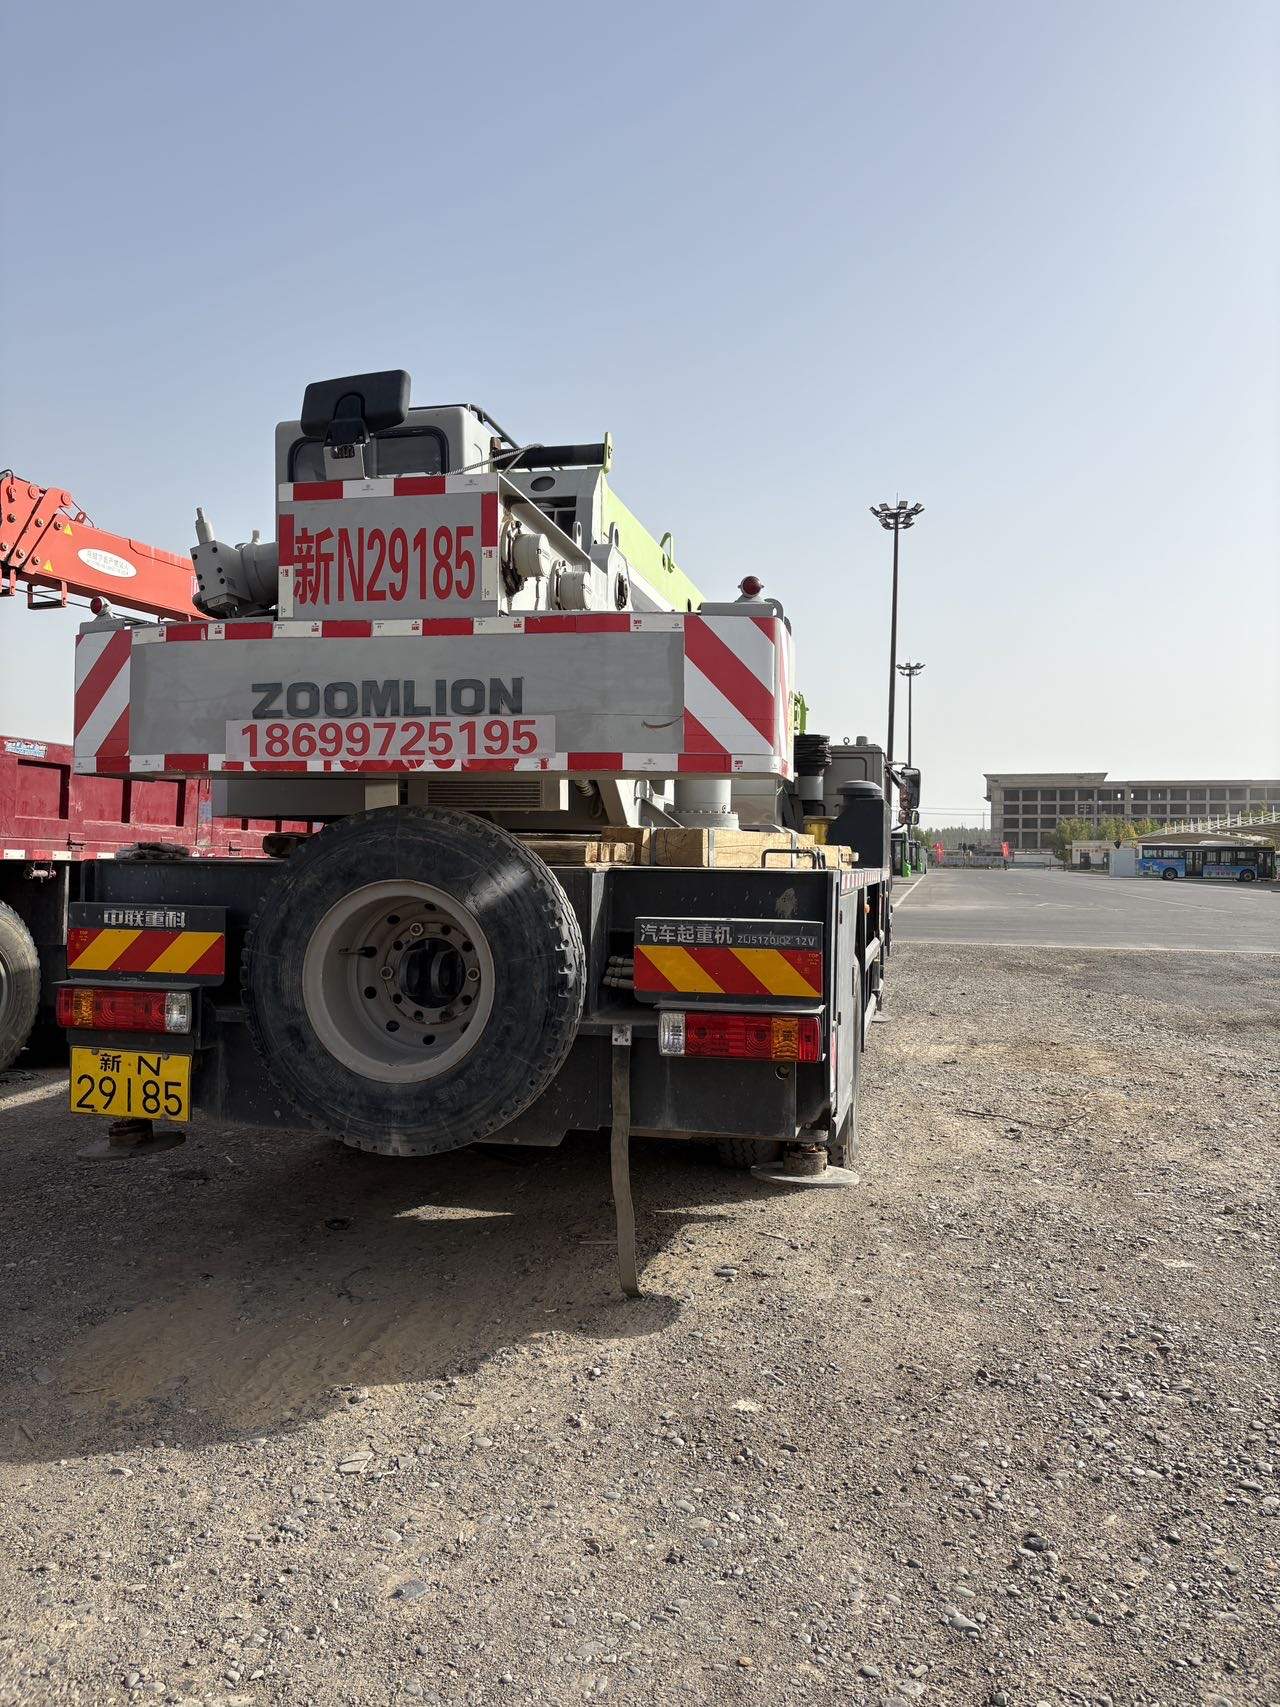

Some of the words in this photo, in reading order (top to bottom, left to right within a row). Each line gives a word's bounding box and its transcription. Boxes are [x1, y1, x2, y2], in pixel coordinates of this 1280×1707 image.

[293, 525, 476, 605] 新N29185
[251, 677, 523, 718] ZOOMLION
[241, 719, 538, 758] 18699725195
[103, 909, 186, 928] 中联重科
[640, 923, 733, 945] 汽车起重机
[795, 936, 815, 946] 12V
[76, 1074, 183, 1116] 29185
